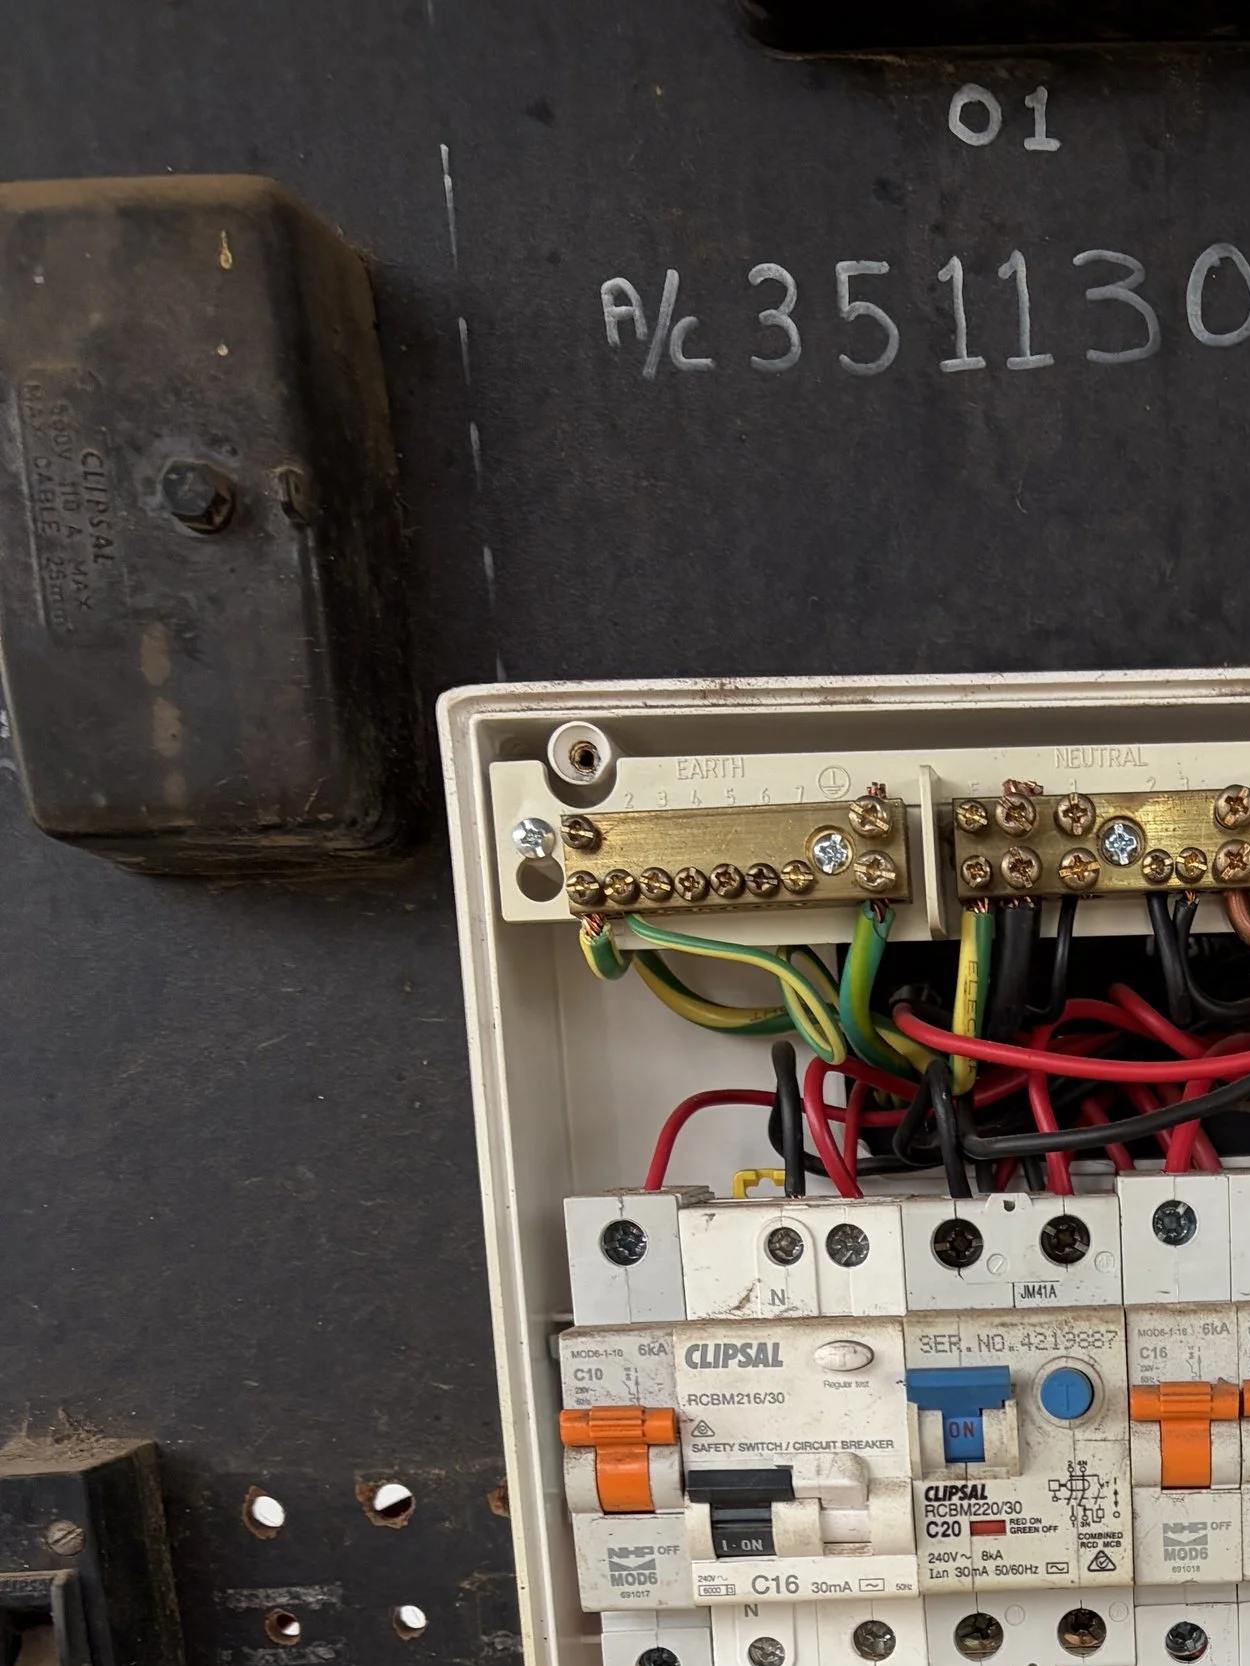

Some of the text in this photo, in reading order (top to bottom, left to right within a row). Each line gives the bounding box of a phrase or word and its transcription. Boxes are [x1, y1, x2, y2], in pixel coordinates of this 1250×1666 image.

[948, 83, 1062, 151] 01
[80, 449, 117, 565] CLIPSAL
[1053, 745, 1148, 769] NEUTRAL
[674, 755, 746, 782] EARTH
[624, 791, 635, 810] 2
[723, 787, 737, 806] 5
[770, 1288, 786, 1307] N
[1019, 1283, 1058, 1300] JM41A
[1202, 1322, 1231, 1336] 6kA
[637, 1342, 669, 1357] 6kA
[684, 1341, 784, 1370] CLIPSAL
[1138, 1346, 1169, 1360] C16
[573, 1367, 604, 1382] C10
[823, 1379, 871, 1390] Regular test
[686, 1391, 786, 1407] RCBM216/30
[949, 1421, 975, 1439] ON
[691, 1438, 895, 1453] SAFETY SWITCH CIRCUIT BREAKER
[924, 1483, 989, 1503] CLIPSAL
[924, 1500, 1023, 1518] RCBM220/30
[926, 1519, 963, 1539] C20
[1009, 1517, 1043, 1526] RED ON
[1161, 1520, 1233, 1535] NHP OFF
[1009, 1525, 1060, 1535] GREEN OFF
[1077, 1531, 1124, 1541] COMBINED
[606, 1544, 681, 1561] NHP OFF
[740, 1539, 765, 1551] ON
[1079, 1540, 1122, 1549] RCD MCB
[981, 1550, 1005, 1561] 8kA
[1163, 1546, 1209, 1562] MOD6
[954, 1563, 1040, 1578] 30mA 50/60Hz
[610, 1571, 658, 1588] MOD6
[751, 1573, 913, 1596] C16 30mA 50Hz
[743, 1603, 760, 1618] N
